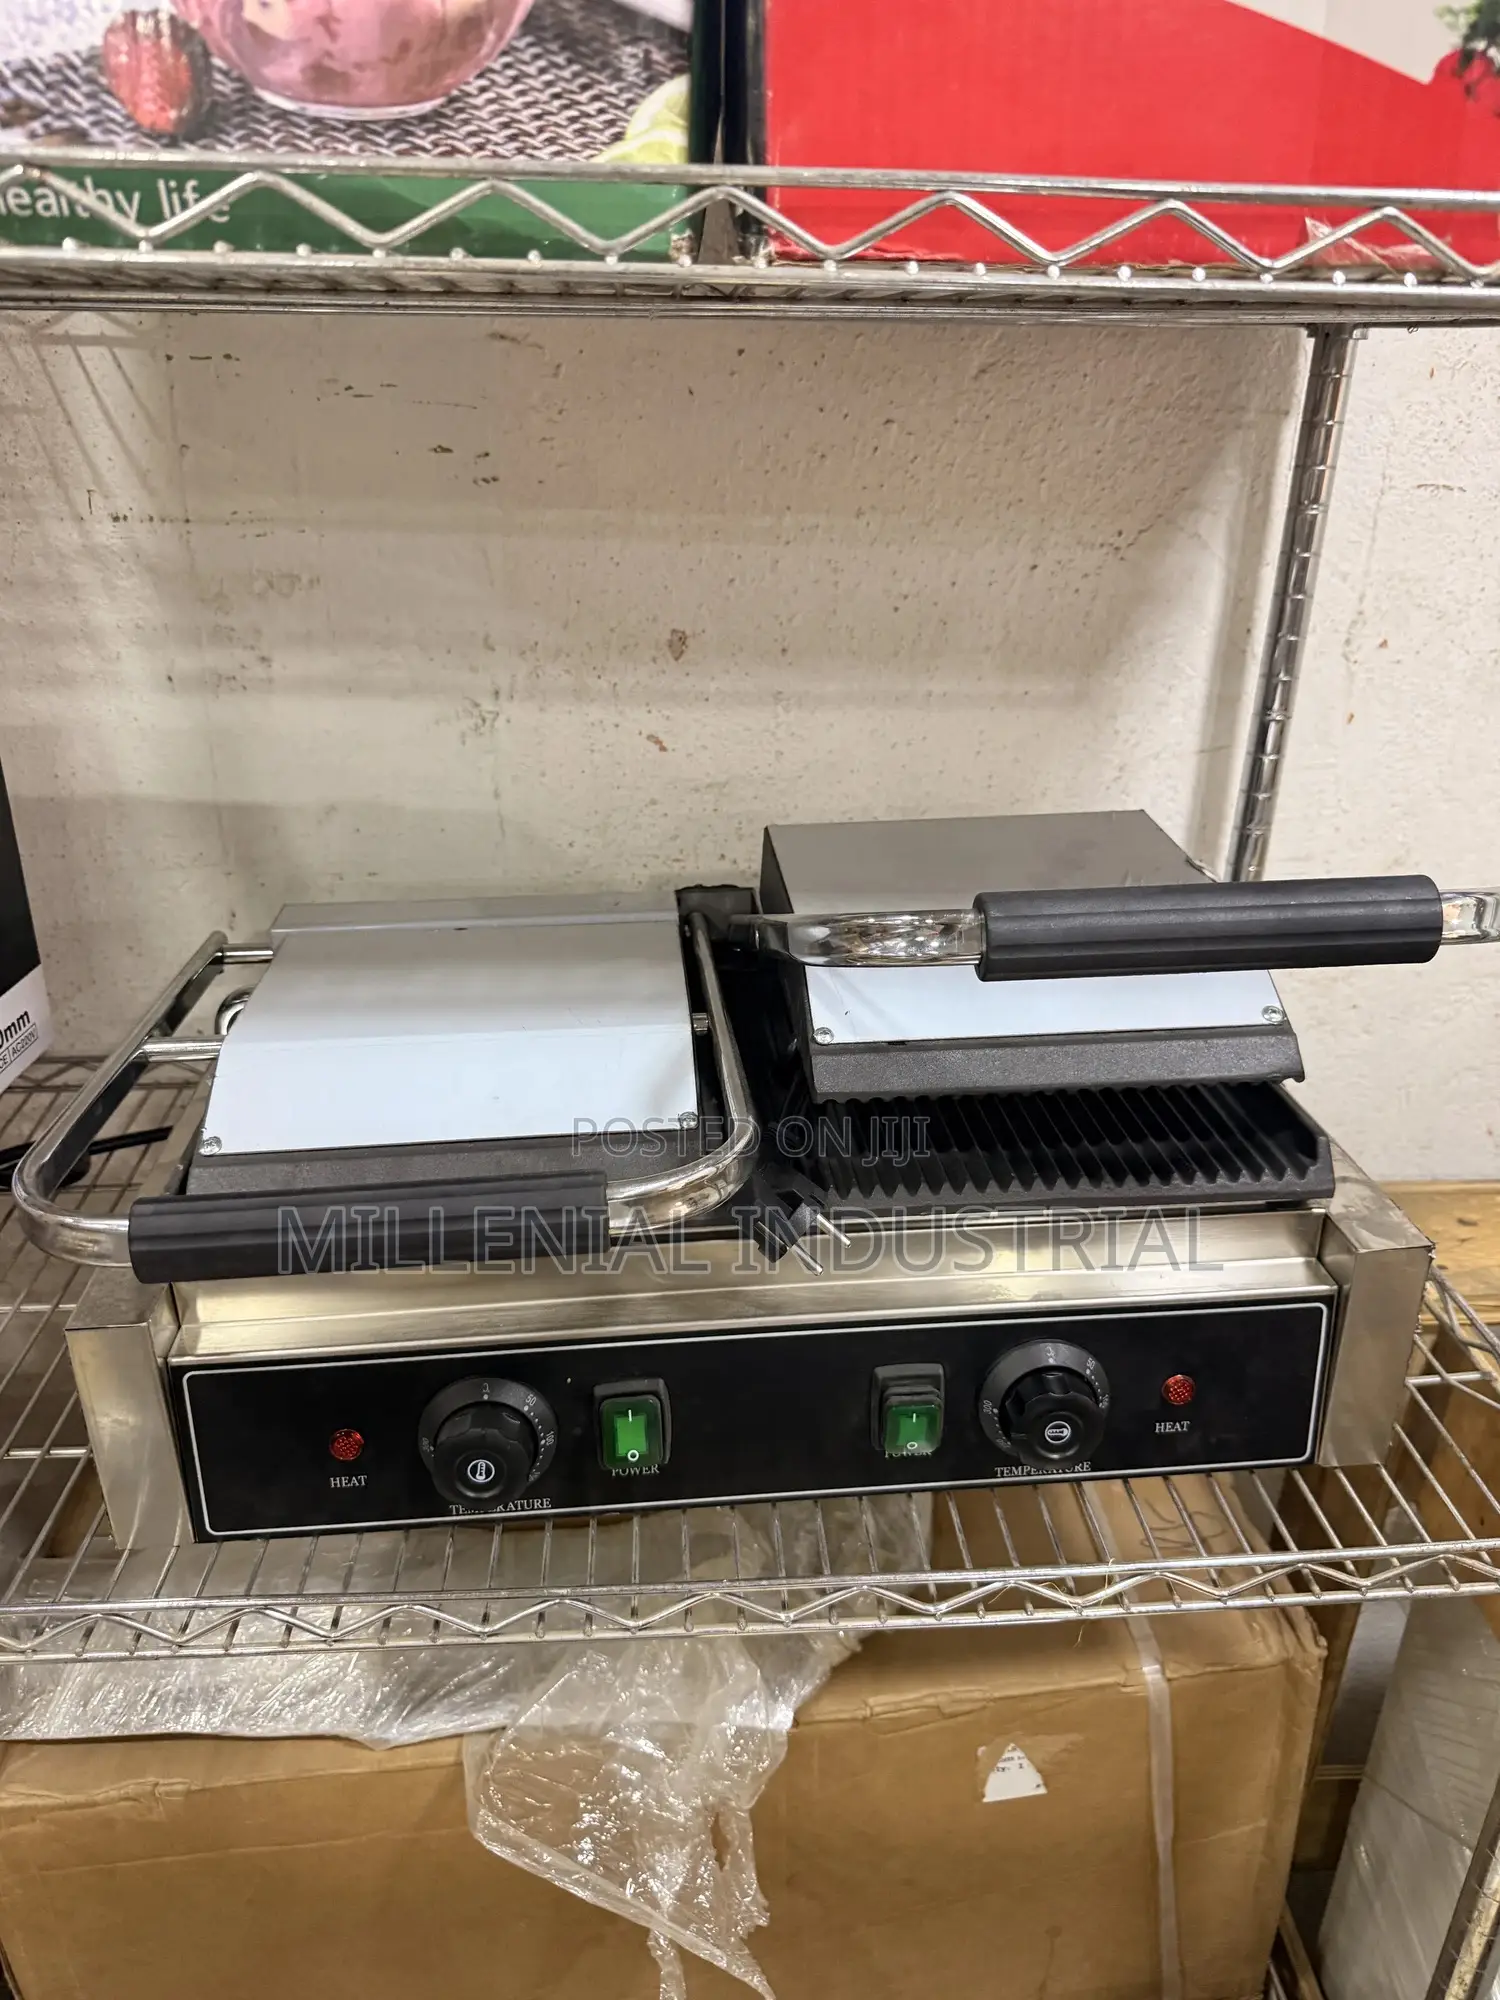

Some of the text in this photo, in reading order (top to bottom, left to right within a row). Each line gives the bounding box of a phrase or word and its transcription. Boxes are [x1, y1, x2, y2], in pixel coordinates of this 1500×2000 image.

[525, 1393, 537, 1406] 50
[1154, 1420, 1191, 1433] HEAT
[611, 1463, 660, 1477] POWER
[994, 1461, 1092, 1477] TEMPERE
[330, 1475, 368, 1488] HEAT
[450, 1498, 552, 1516] TERATURE
